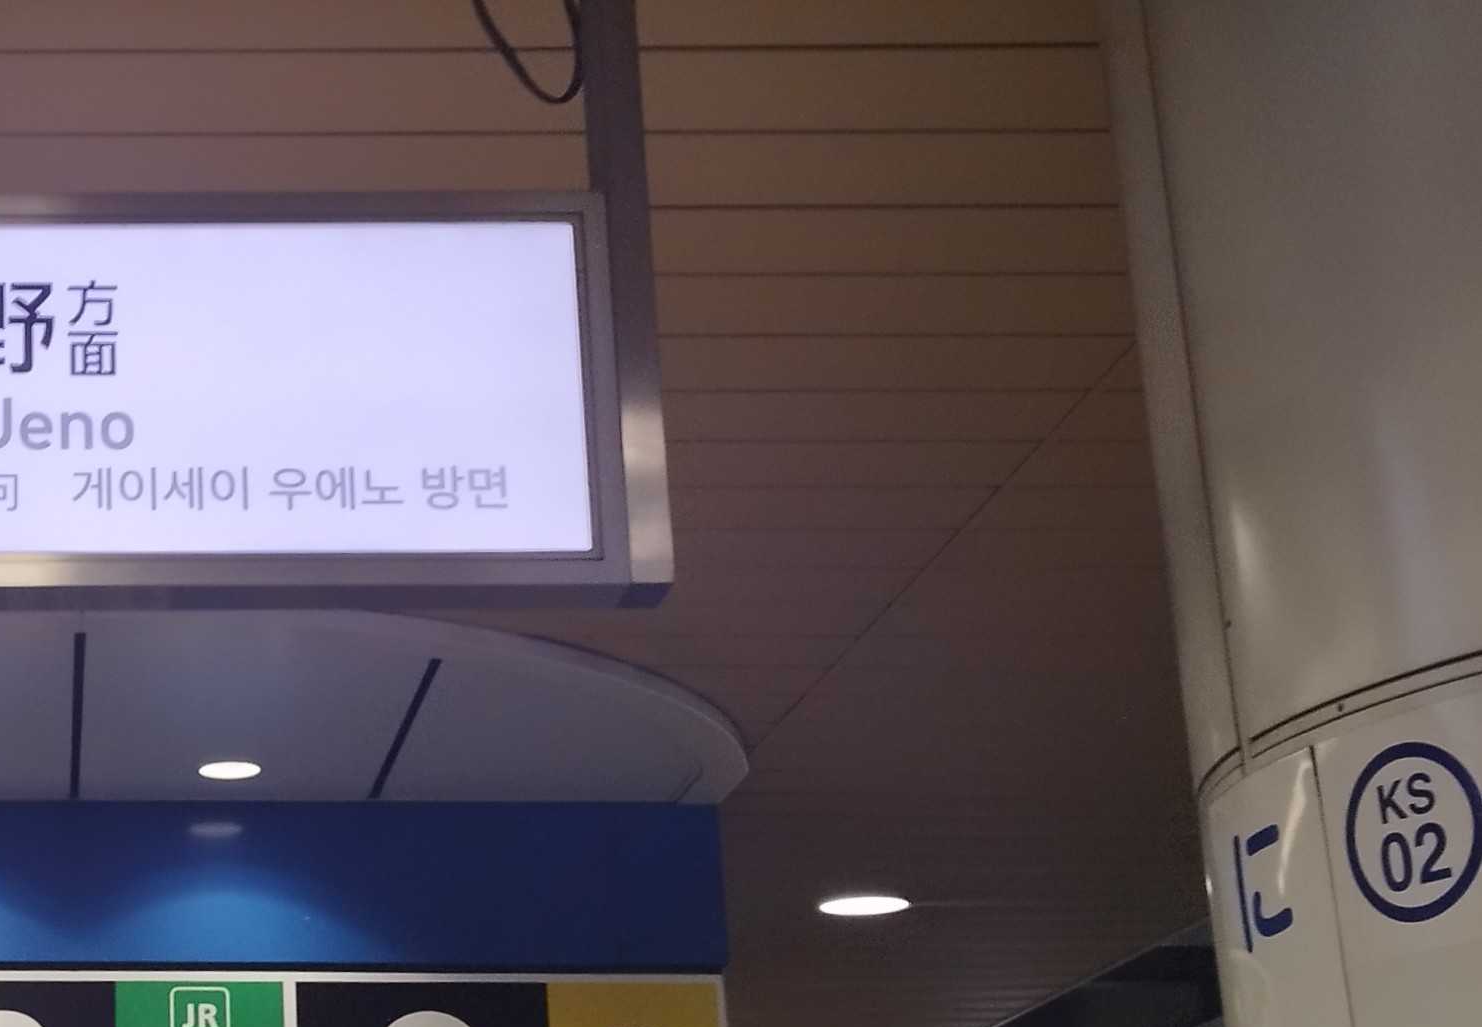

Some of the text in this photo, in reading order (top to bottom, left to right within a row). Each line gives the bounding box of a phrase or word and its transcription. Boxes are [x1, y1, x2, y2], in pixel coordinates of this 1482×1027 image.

[72, 465, 509, 511] 게이세이 우에노 방면
[1376, 772, 1436, 824] KS
[1381, 822, 1452, 892] 02
